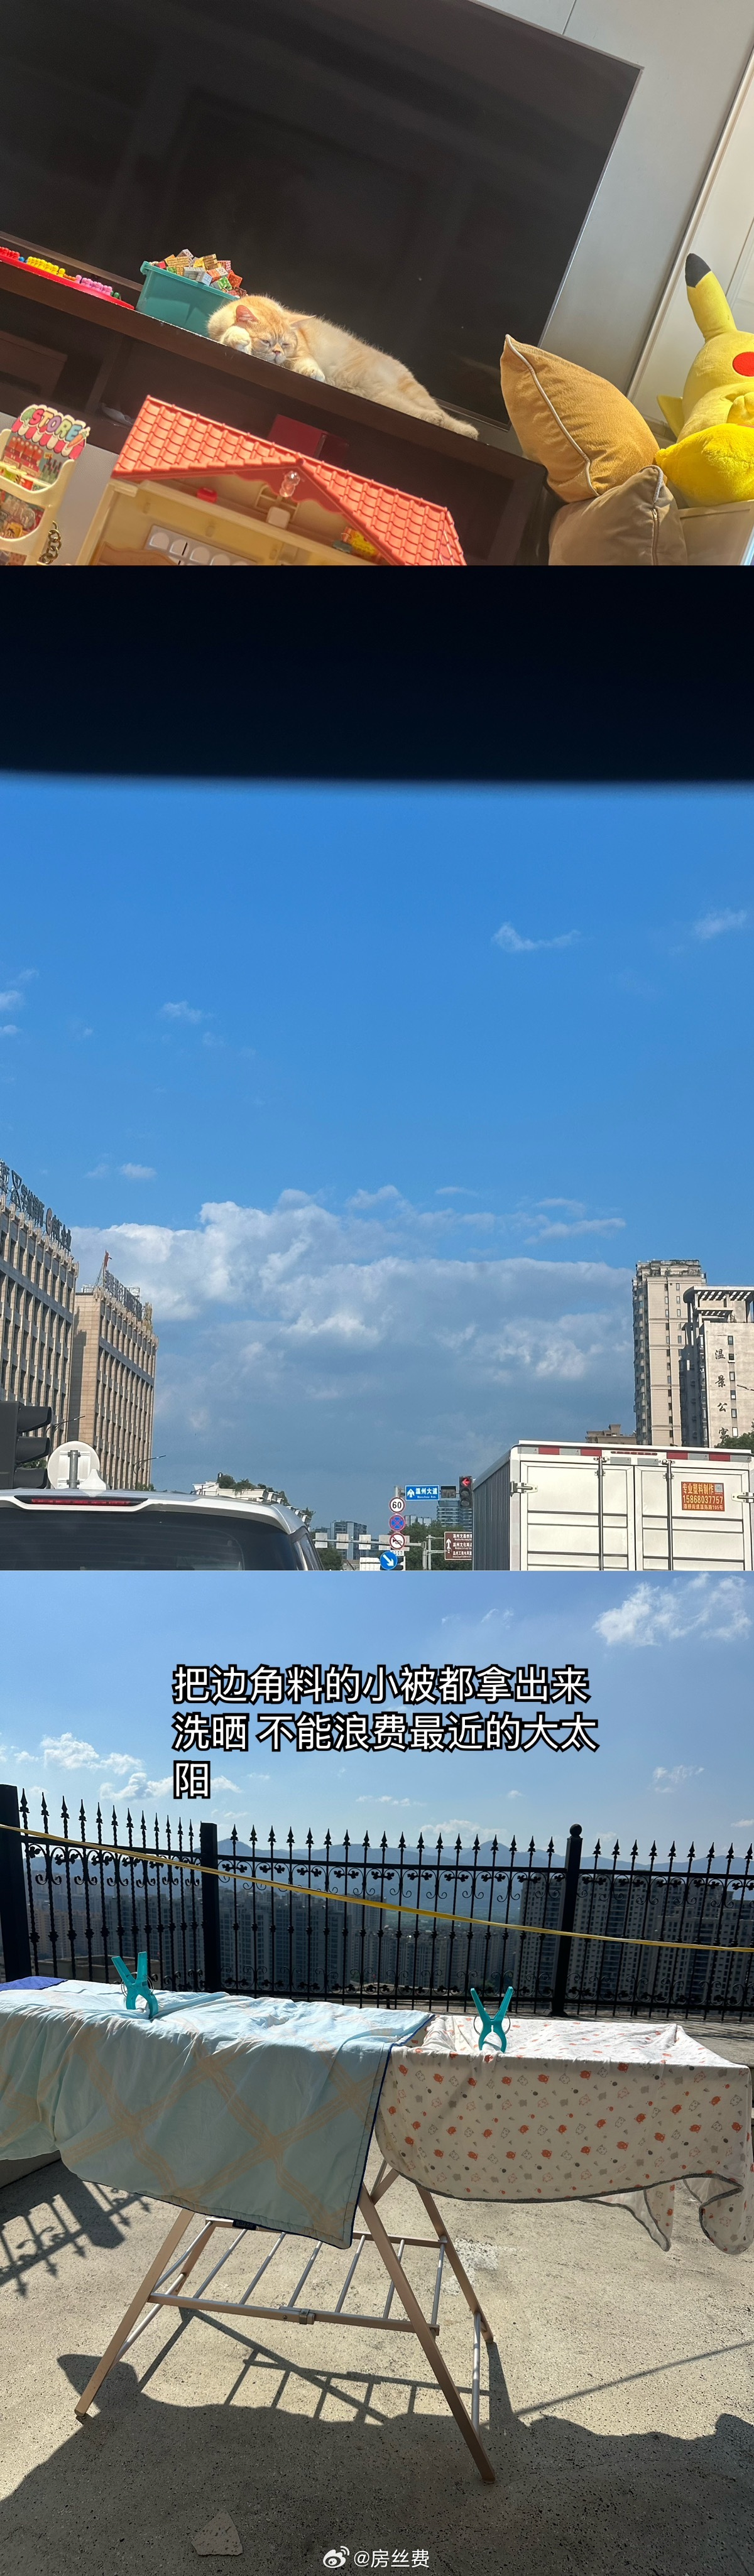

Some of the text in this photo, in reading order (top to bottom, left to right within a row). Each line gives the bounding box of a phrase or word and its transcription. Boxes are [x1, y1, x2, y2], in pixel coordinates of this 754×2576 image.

[30, 408, 82, 441] STORE
[714, 1348, 729, 1440] 温景公寓
[682, 1495, 723, 1504] 15868037757
